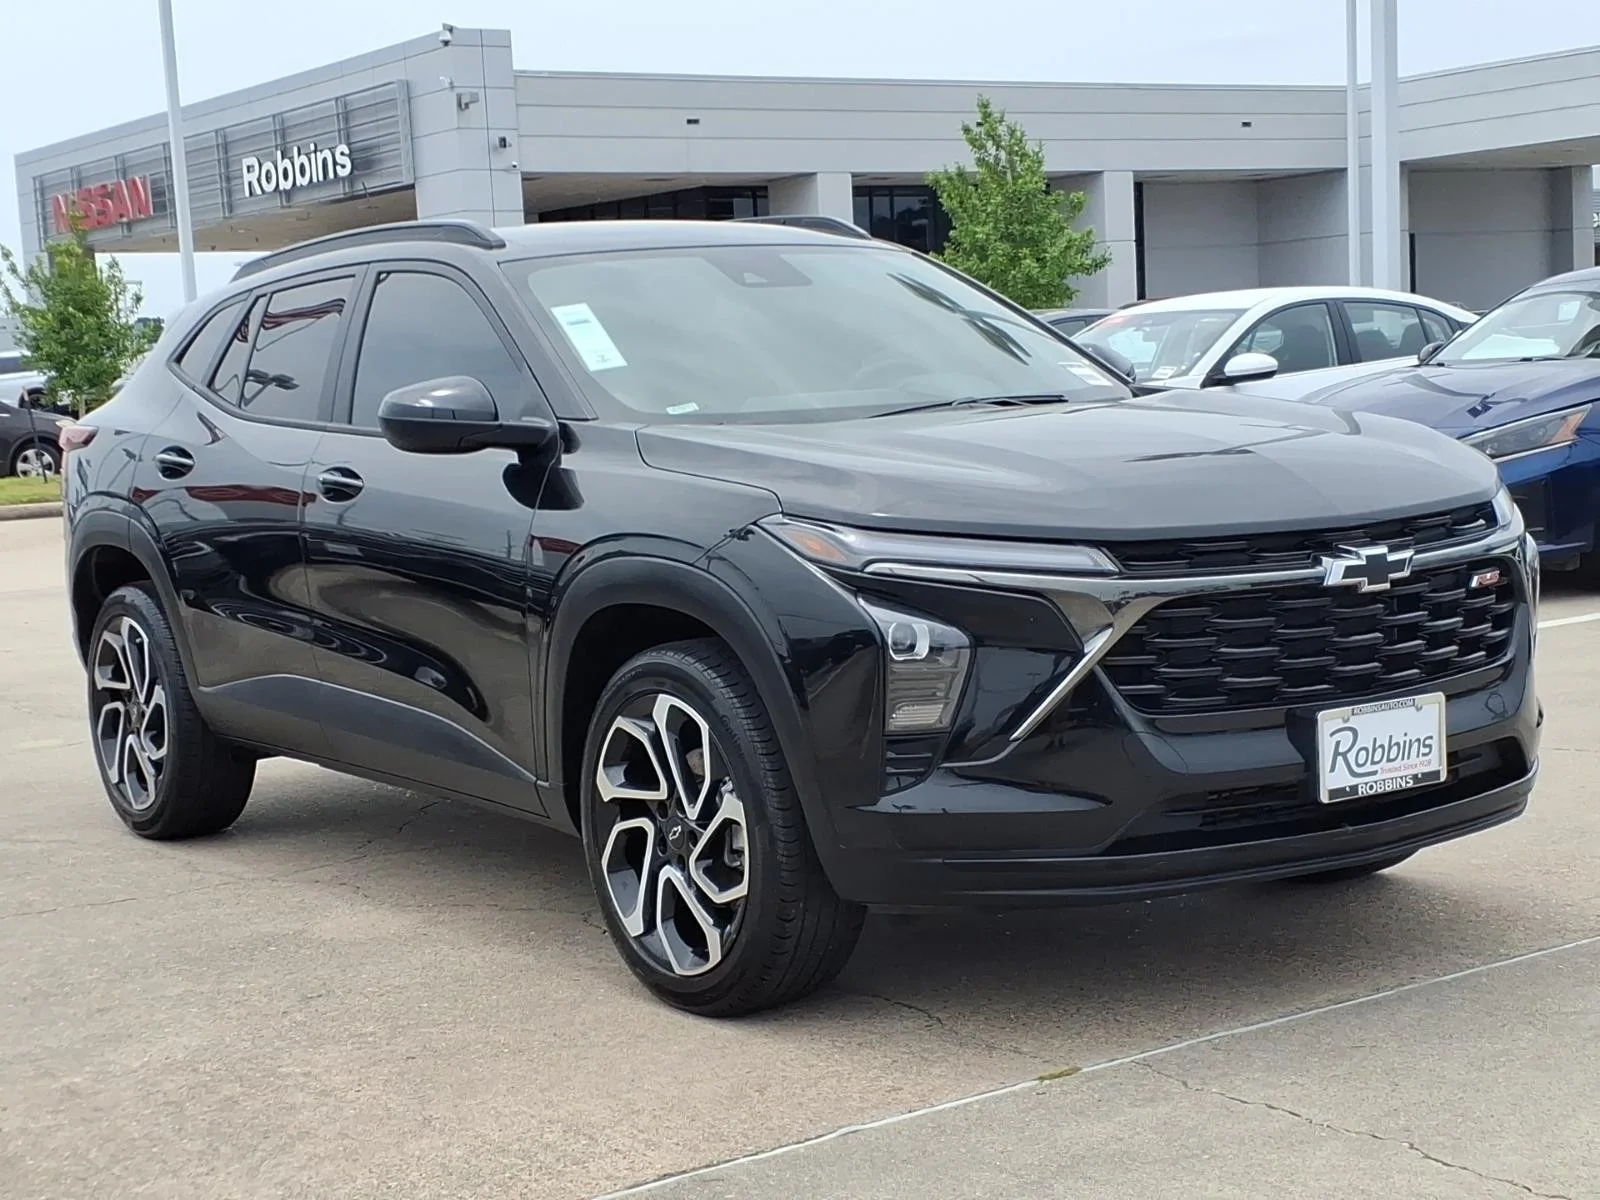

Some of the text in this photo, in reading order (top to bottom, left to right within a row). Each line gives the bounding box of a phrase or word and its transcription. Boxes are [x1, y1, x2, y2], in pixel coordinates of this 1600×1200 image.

[242, 143, 352, 197] Robbins
[1352, 698, 1414, 715] ROBBINSAUTO.COM
[1328, 725, 1434, 778] Robbins
[1403, 762, 1418, 772] Since
[1357, 775, 1414, 796] ROBBINS
